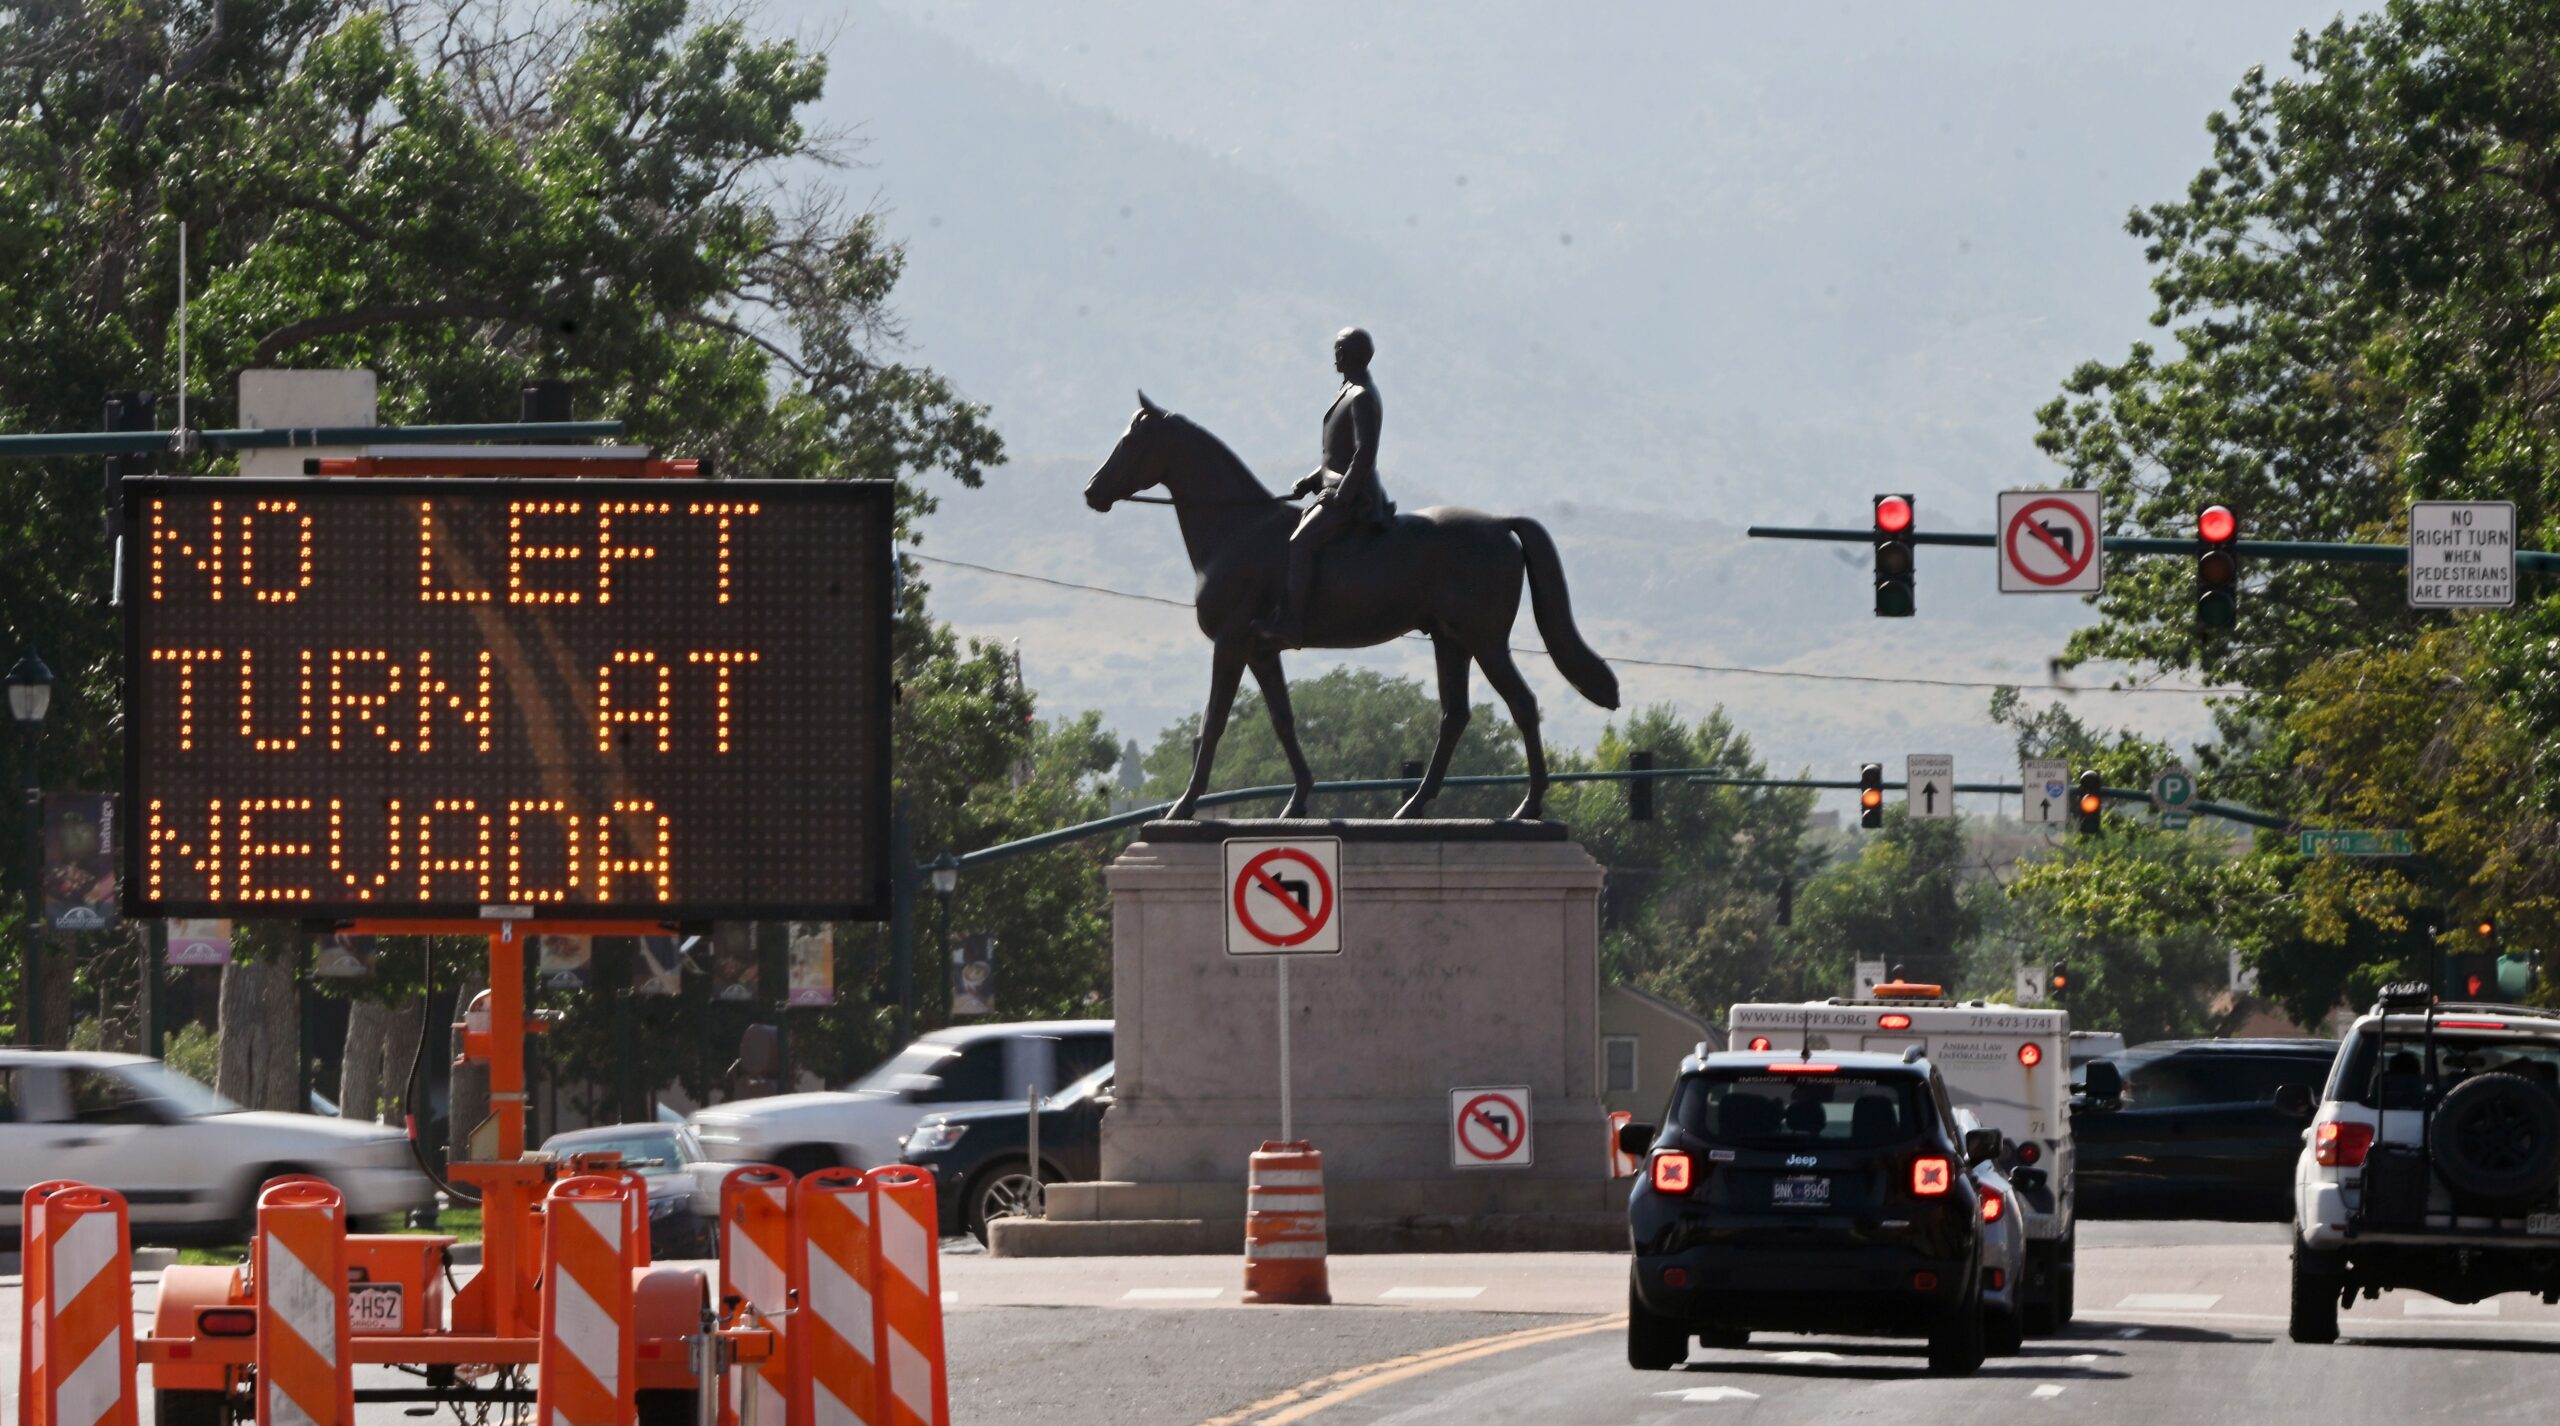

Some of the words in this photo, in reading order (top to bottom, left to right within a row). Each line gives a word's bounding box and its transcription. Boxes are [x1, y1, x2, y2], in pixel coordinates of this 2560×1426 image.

[2451, 510, 2473, 526] NO
[2416, 530, 2462, 545] RIGHT
[2468, 530, 2508, 545] TURN
[153, 501, 311, 602] NO
[422, 502, 759, 604] LEFT
[2444, 550, 2481, 563] WHEN
[2416, 567, 2508, 581] PEDESTRIANS
[2416, 585, 2442, 598] ARE
[2448, 585, 2509, 598] PRESENT
[152, 649, 490, 752] TURN
[599, 651, 759, 753] AT
[1912, 768, 1948, 776] CASCADE
[100, 800, 114, 855] indulge
[151, 799, 669, 901] NEVADA
[1970, 1016, 2052, 1029] 719-473-1741
[2032, 1121, 2045, 1133] 71
[1786, 1154, 1818, 1167] Jeep
